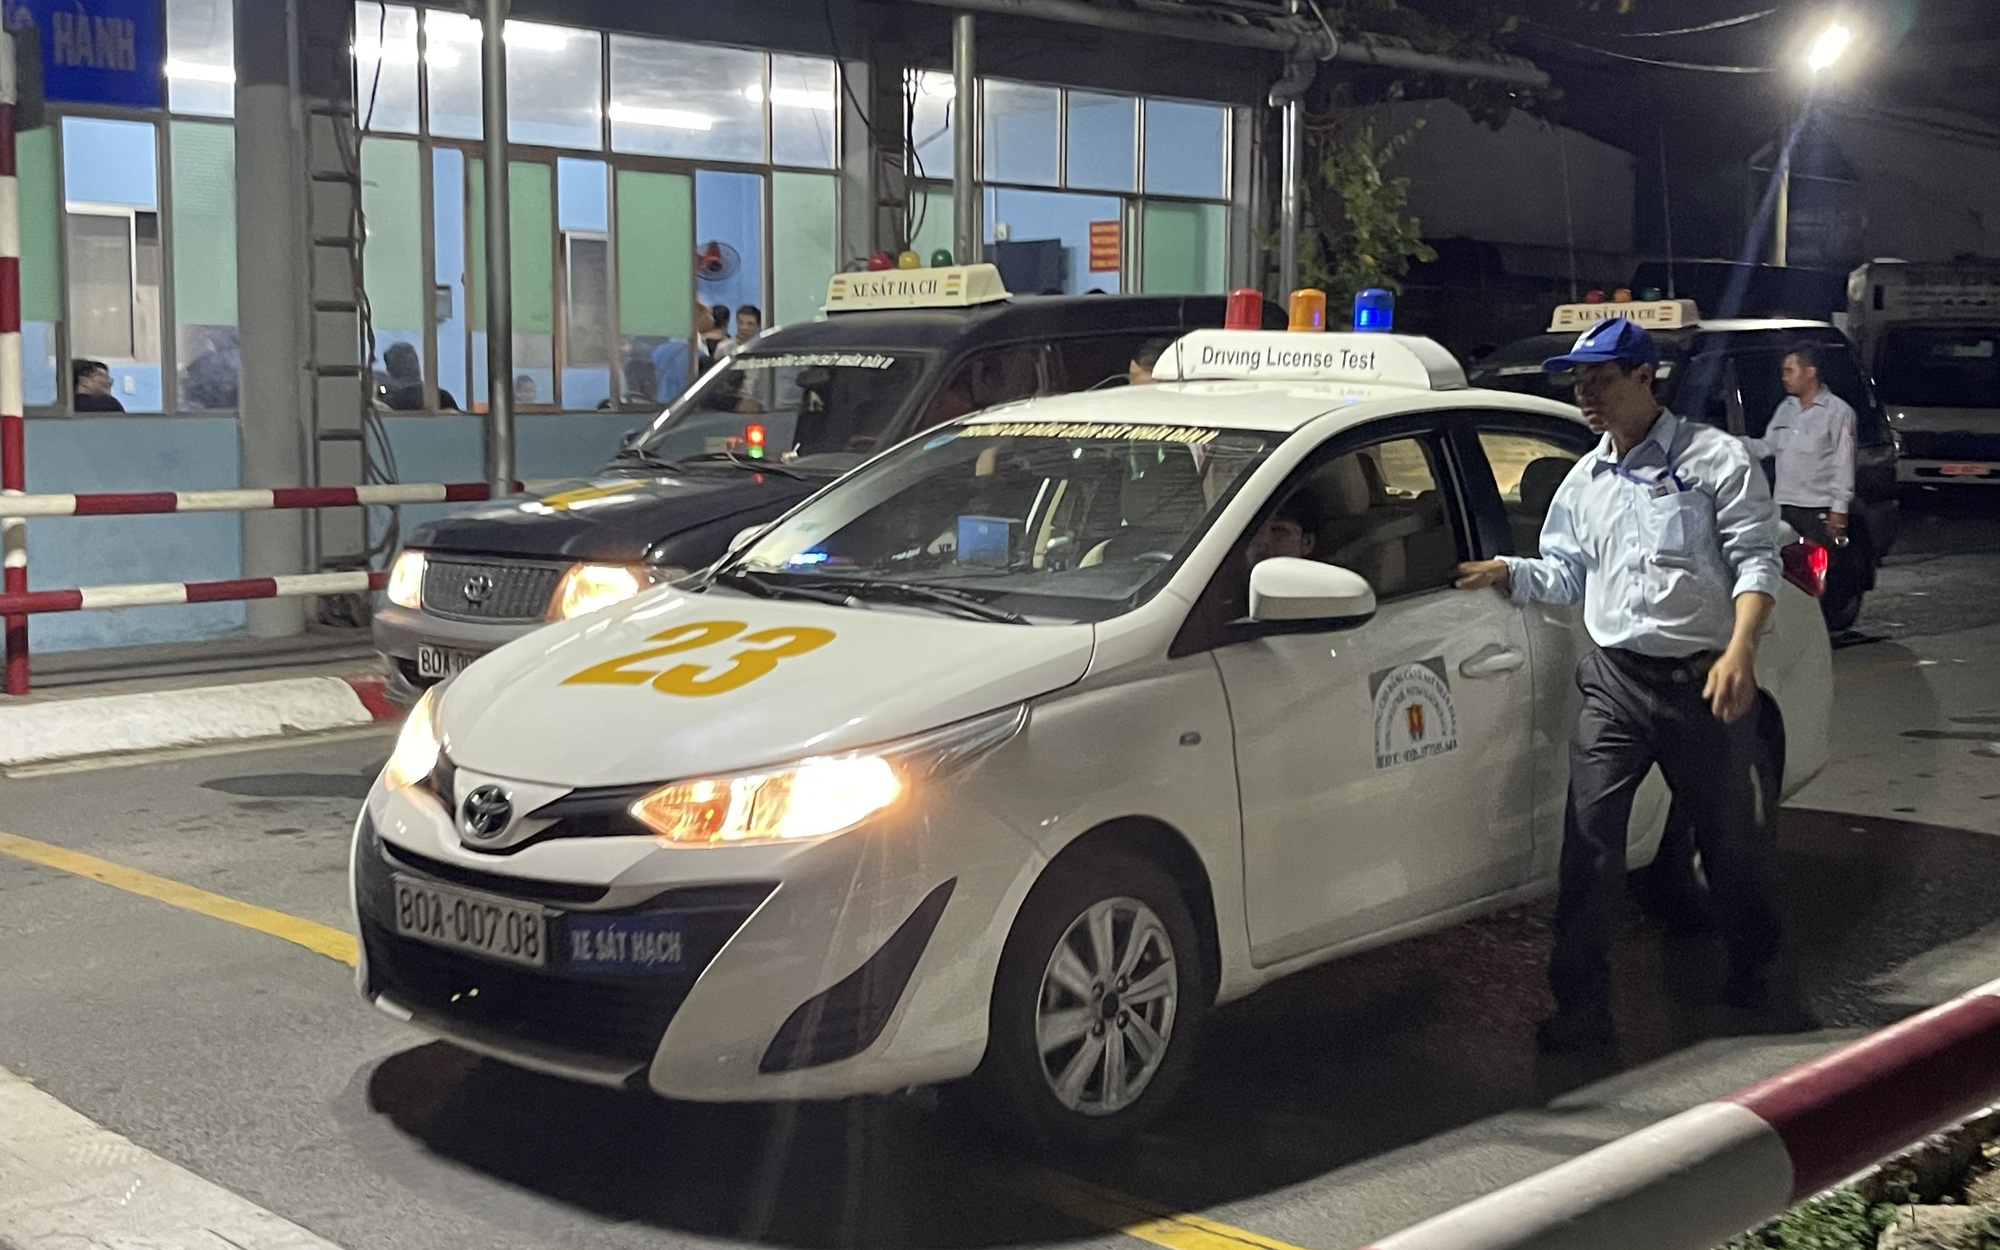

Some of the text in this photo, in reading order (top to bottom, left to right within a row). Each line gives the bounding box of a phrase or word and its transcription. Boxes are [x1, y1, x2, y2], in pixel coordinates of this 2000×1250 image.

[53, 1, 136, 71] HÀNH
[852, 282, 869, 298] XE
[871, 276, 896, 297] SÁT
[1202, 345, 1376, 371] Driving License Test
[557, 621, 837, 697] 23
[400, 888, 539, 958] 80A-007.08
[570, 923, 681, 966] XE SÁT HẠCH
